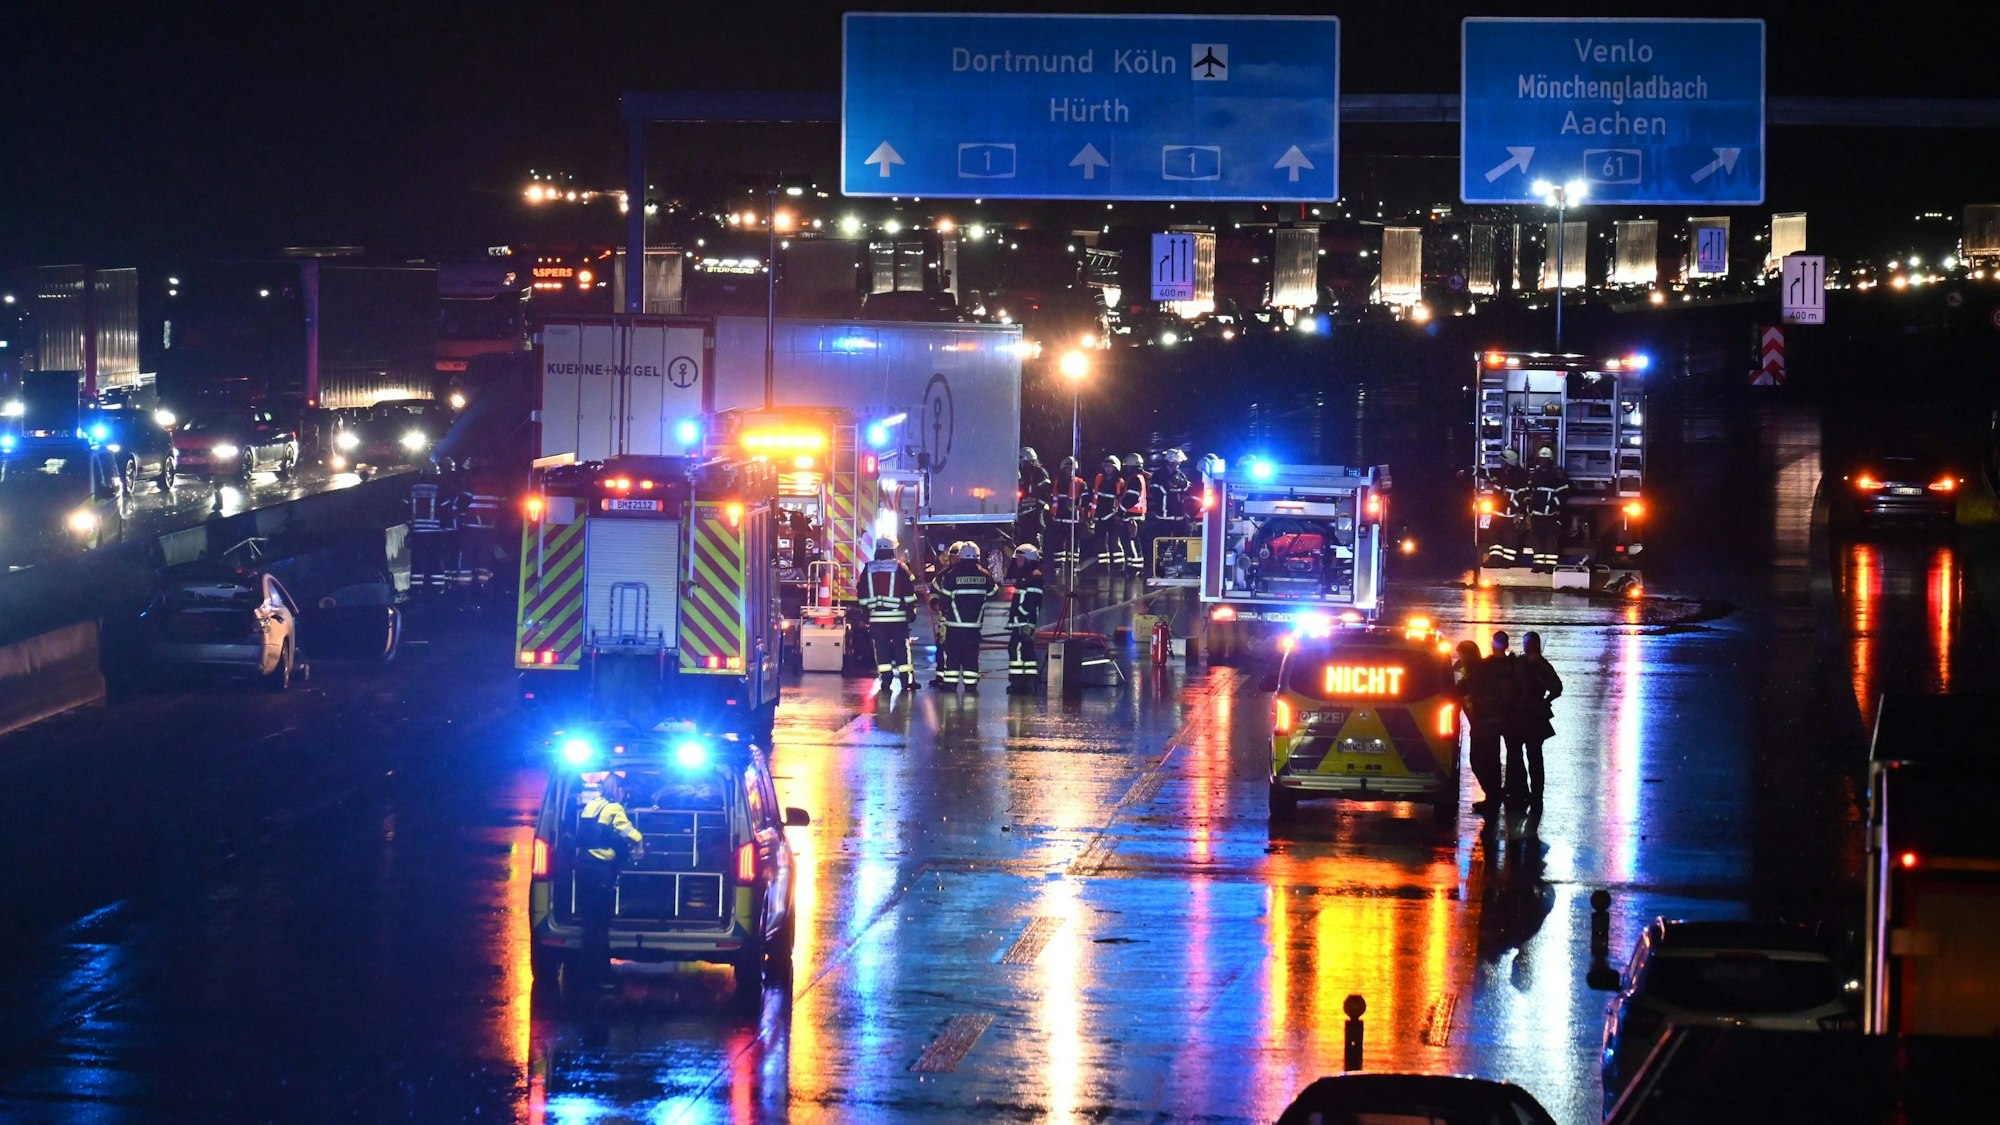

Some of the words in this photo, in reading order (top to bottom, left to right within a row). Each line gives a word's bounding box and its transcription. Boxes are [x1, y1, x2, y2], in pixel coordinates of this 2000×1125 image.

[952, 47, 1093, 74] Dortmund
[1114, 48, 1177, 74] Köln
[1574, 38, 1653, 63] Venlo
[1518, 74, 1708, 106] Mönchengladbach
[1050, 97, 1129, 123] Hürth
[1560, 110, 1666, 136] Aachen
[983, 150, 991, 172] 1
[1187, 151, 1196, 174] 1
[1602, 156, 1623, 177] 61
[1159, 288, 1176, 297] 400
[1790, 311, 1807, 320] 400
[547, 362, 661, 378] KUEHNE+NAGEL
[1325, 665, 1405, 695] NICHT
